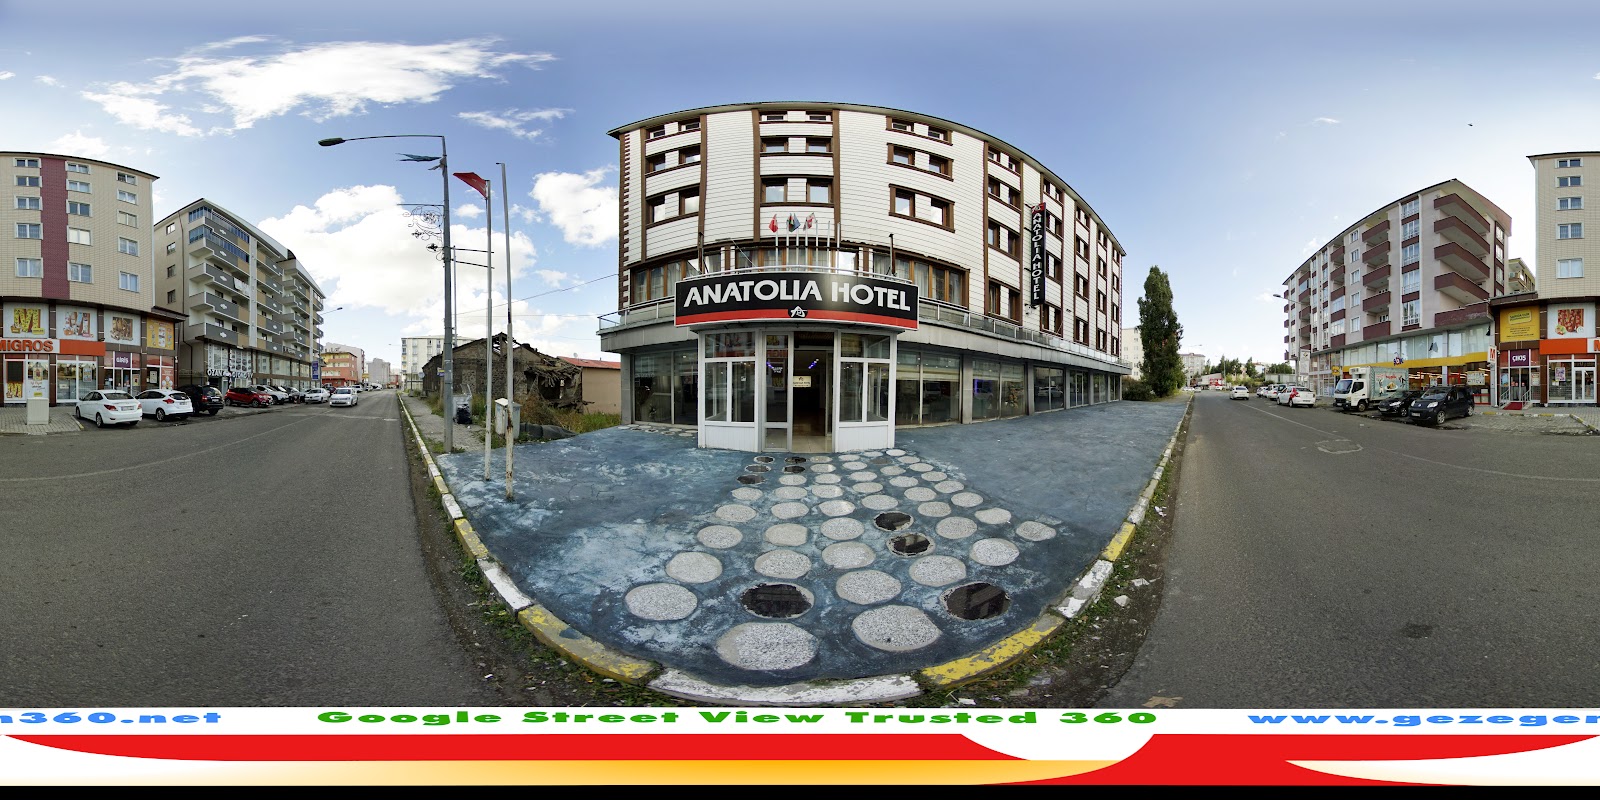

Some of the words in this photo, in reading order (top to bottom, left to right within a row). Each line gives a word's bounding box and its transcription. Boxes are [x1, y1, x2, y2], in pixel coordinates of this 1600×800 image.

[1031, 212, 1043, 261] ANATOLIA
[683, 279, 822, 307] ANATOLIA
[831, 281, 911, 311] HOTEL
[1031, 262, 1043, 300] HOTEL
